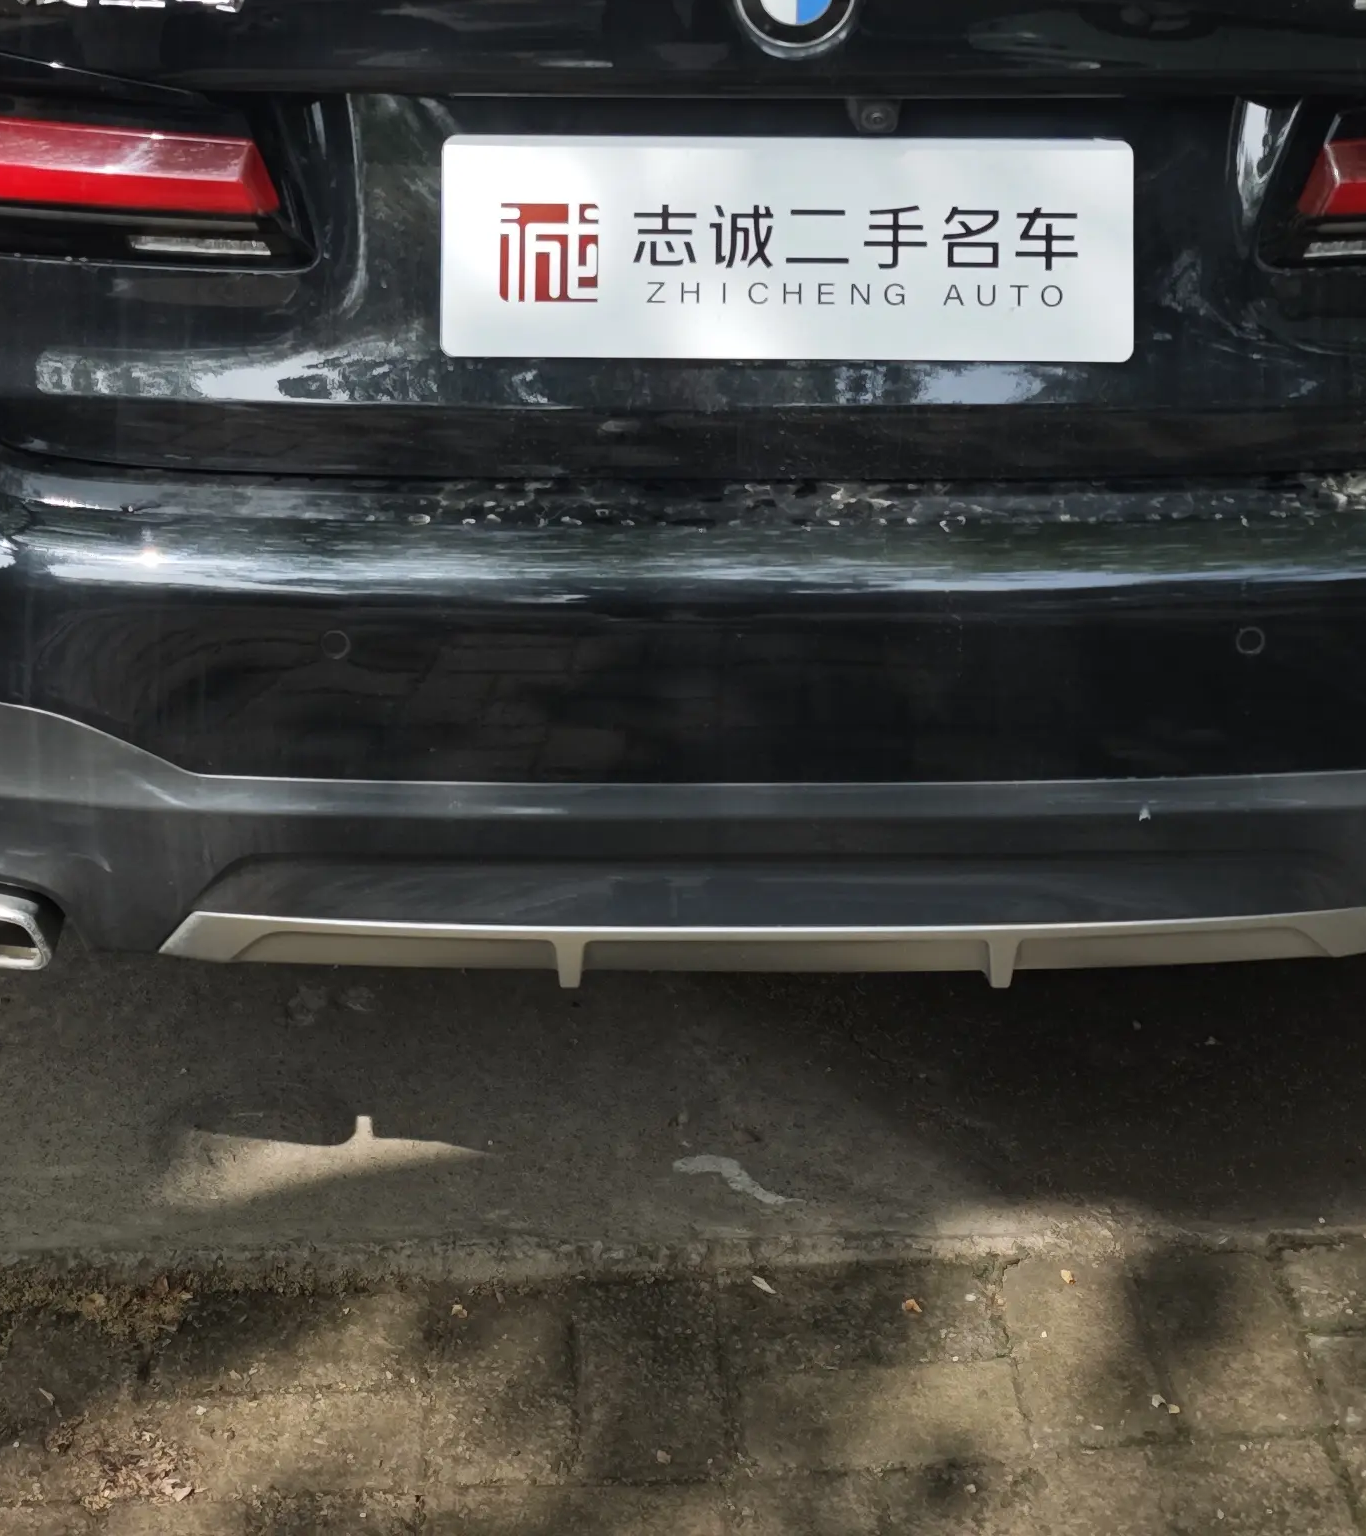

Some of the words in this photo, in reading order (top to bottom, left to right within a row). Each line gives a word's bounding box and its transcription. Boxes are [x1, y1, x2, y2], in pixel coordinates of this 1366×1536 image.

[633, 204, 1079, 271] 志诚二手名车
[646, 281, 907, 307] ZHICHENG
[943, 283, 1065, 308] AUTO
